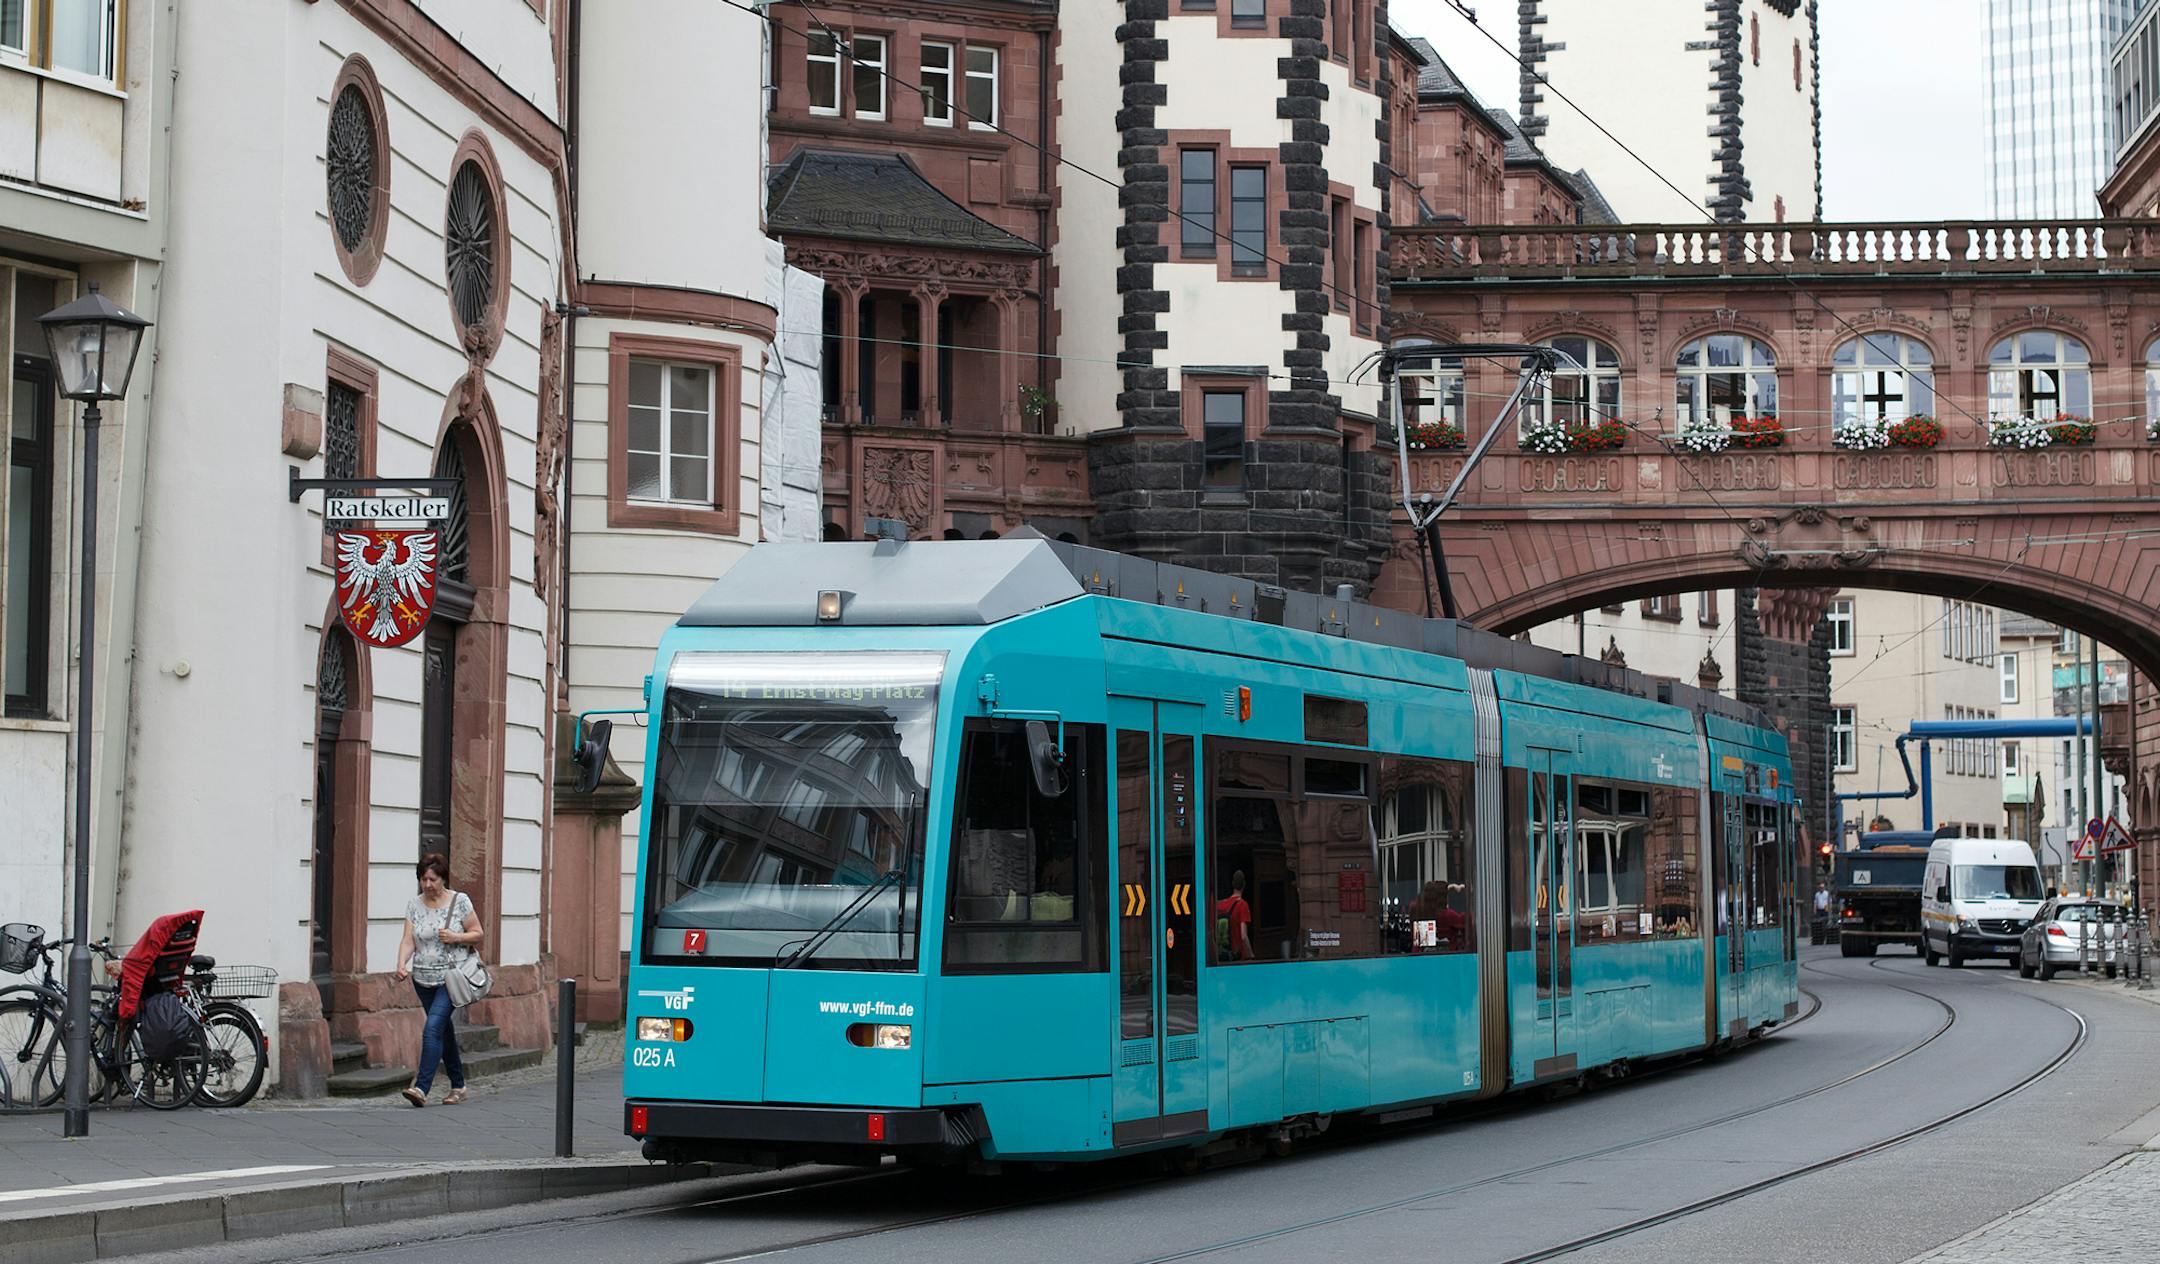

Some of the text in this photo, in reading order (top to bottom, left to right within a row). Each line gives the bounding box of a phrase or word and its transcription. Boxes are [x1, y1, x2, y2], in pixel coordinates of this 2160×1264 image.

[329, 499, 446, 518] Ratskeller
[762, 681, 926, 701] Ernst-May-Platz
[1858, 873, 1867, 882] A
[690, 933, 700, 946] 7
[664, 986, 695, 1010] VGF
[819, 1000, 914, 1017] www.vgf-ffm.de
[633, 1047, 676, 1068] 025 A
